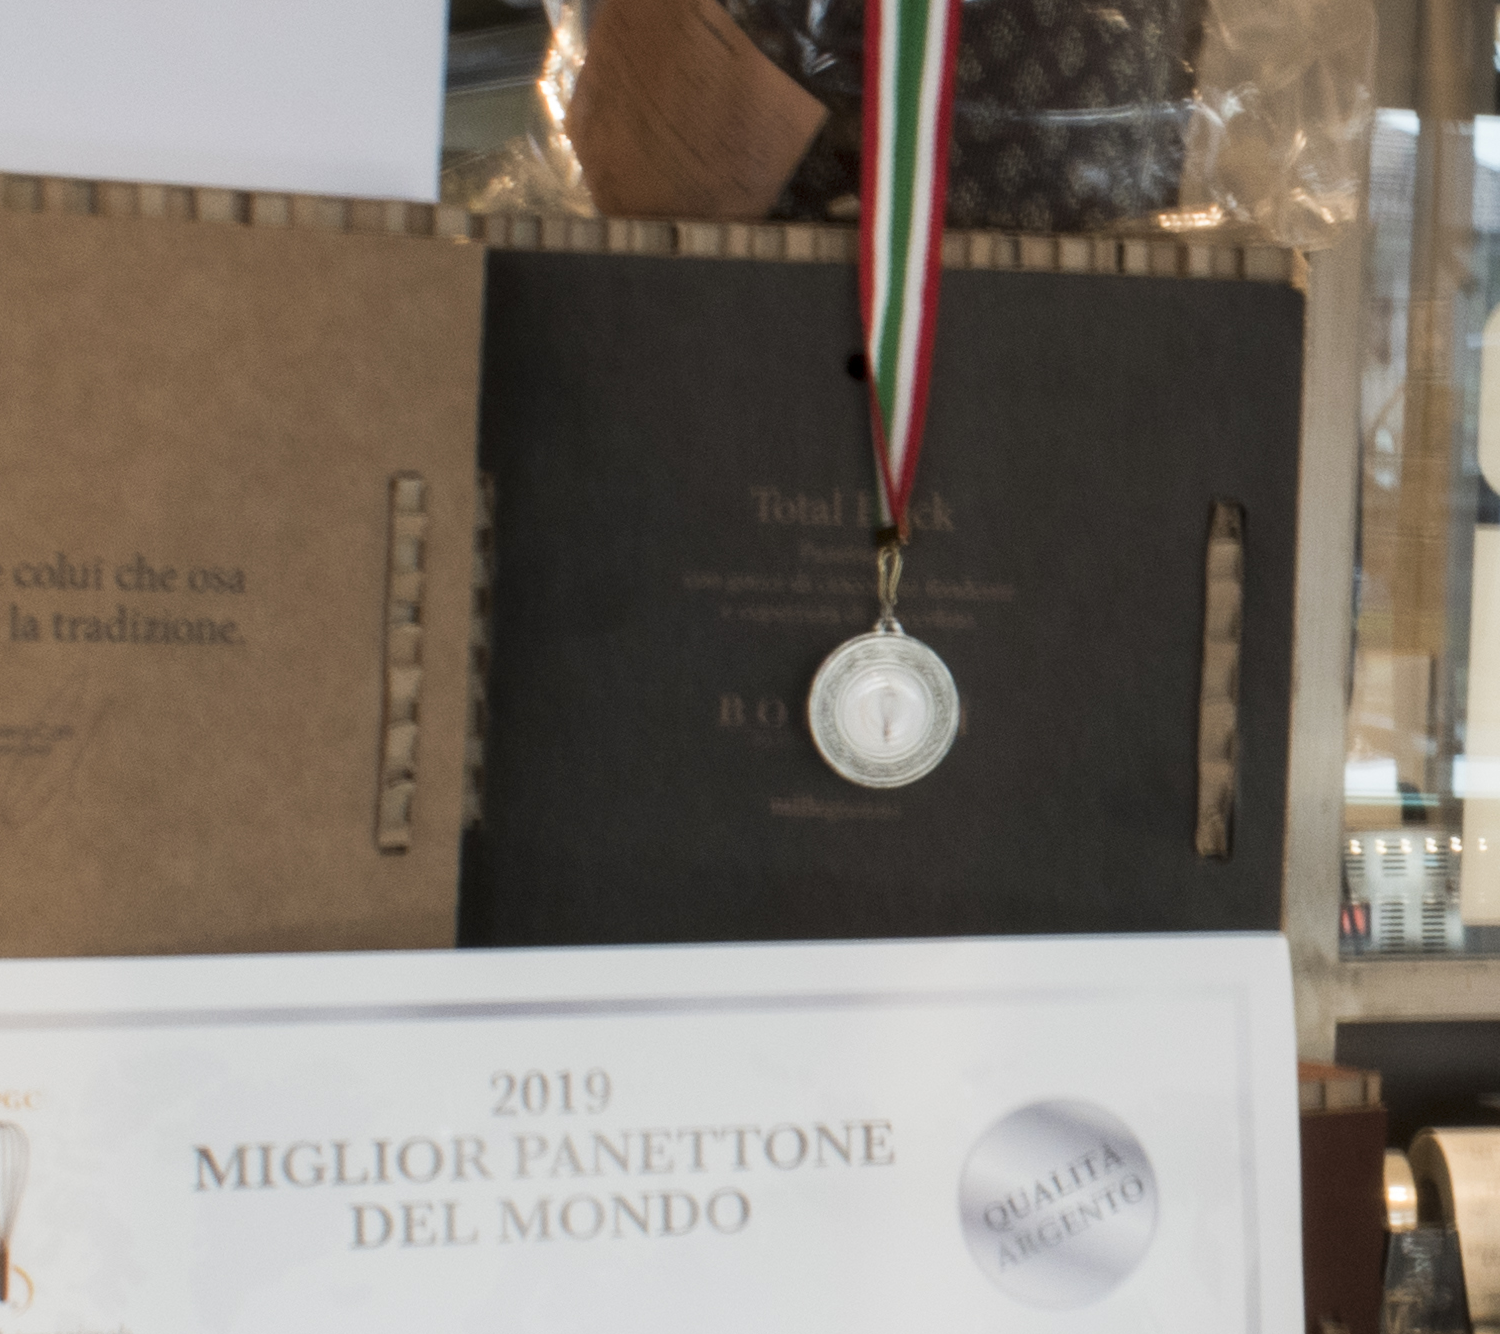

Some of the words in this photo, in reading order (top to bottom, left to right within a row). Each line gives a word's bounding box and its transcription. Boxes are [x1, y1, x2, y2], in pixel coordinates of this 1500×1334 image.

[749, 486, 844, 527] Total
[12, 551, 104, 590] colui
[114, 552, 179, 594] che
[187, 565, 246, 595] osa
[9, 602, 40, 642] la
[52, 604, 246, 646] tradizione.
[489, 1069, 614, 1116] 2019
[192, 1133, 493, 1192] MIGLIOR
[512, 1118, 897, 1182] PANETTONE
[350, 1200, 479, 1250] DEL
[499, 1187, 752, 1244] MONDO
[999, 1173, 1146, 1274] ARGENTO
